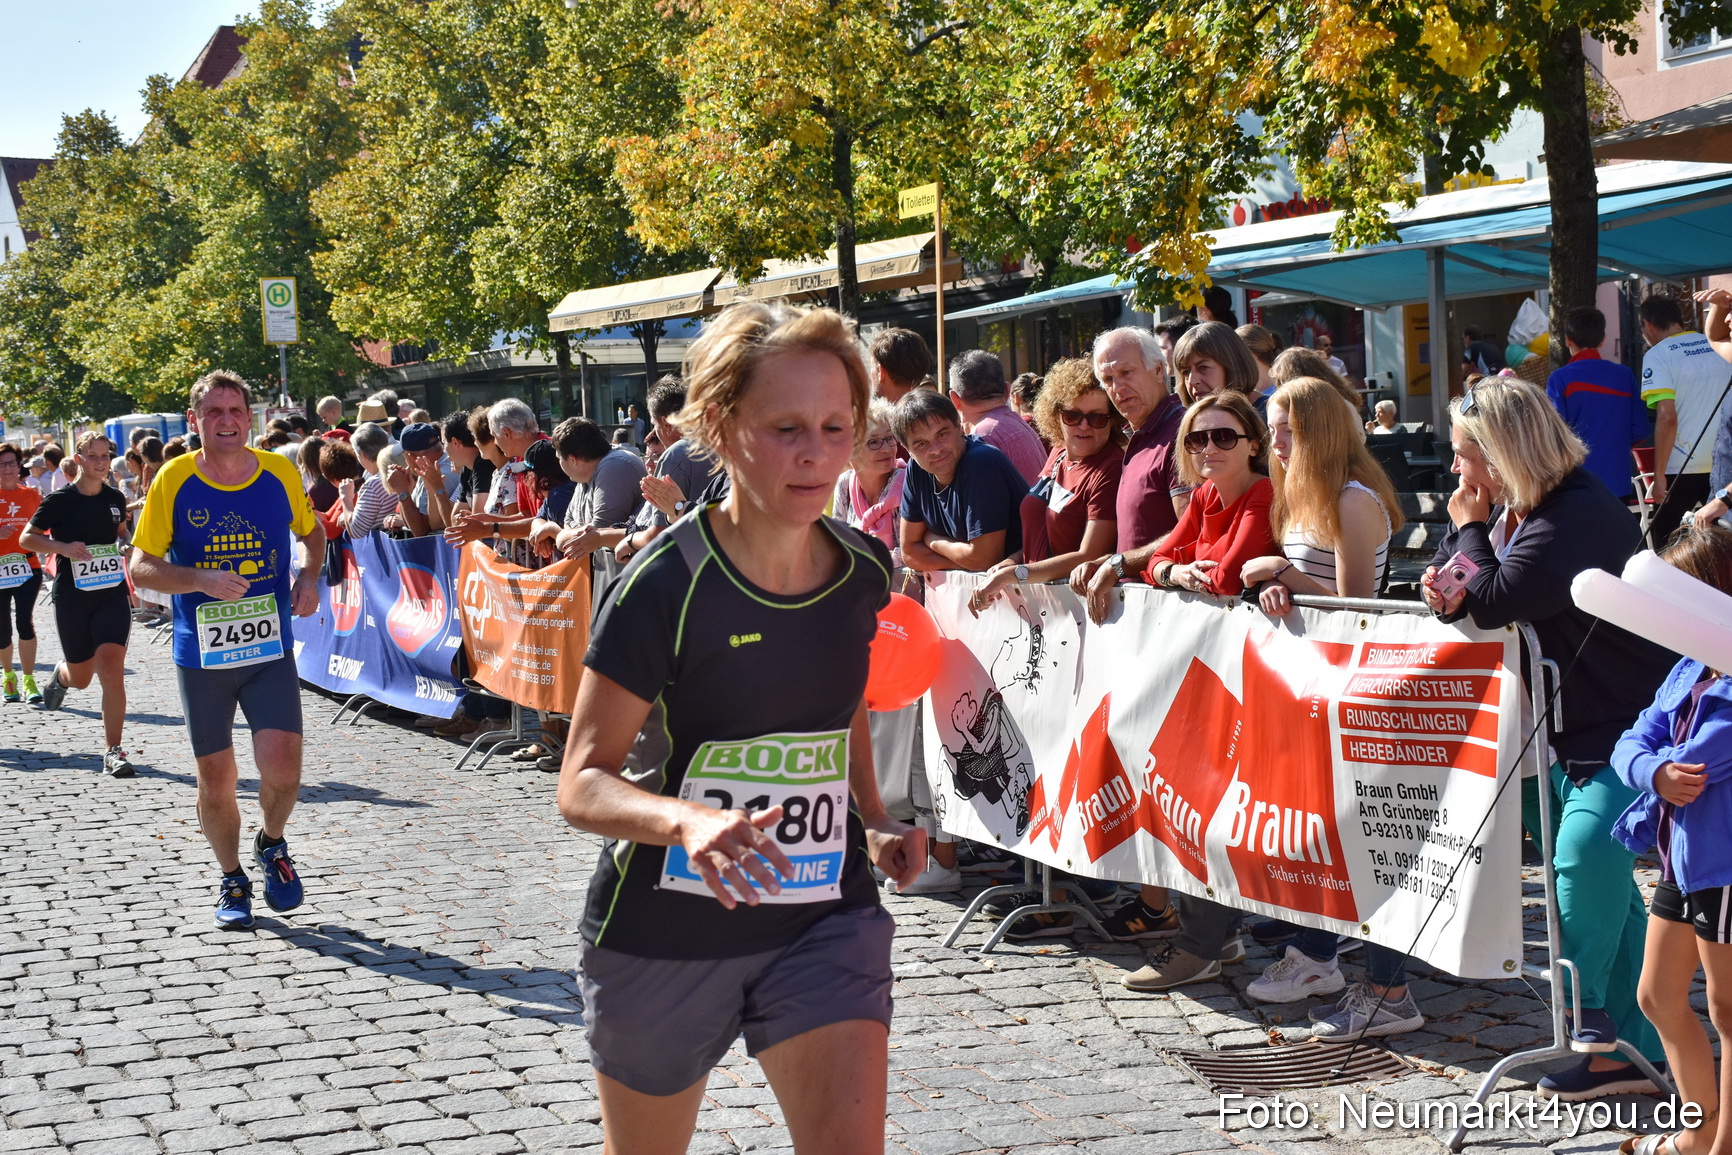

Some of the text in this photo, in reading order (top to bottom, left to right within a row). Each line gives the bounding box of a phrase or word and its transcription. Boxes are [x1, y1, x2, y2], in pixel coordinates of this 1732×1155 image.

[905, 193, 936, 210] Toiletten
[1668, 339, 1708, 351] 20. Neumar
[1683, 347, 1715, 357] Stadtlau
[78, 558, 119, 577] 2449
[543, 572, 567, 583] Partner
[538, 586, 574, 602] Umsetzung
[203, 598, 271, 621] BOCK
[534, 601, 564, 613] Internet,
[208, 619, 272, 648] 2490
[549, 618, 576, 631] angeht.
[740, 633, 762, 644] JAKO
[878, 629, 908, 642] energie
[223, 646, 262, 662] PETER
[533, 644, 544, 655] bei
[1366, 647, 1438, 665] BINDESTRICKE
[540, 674, 556, 686] 897
[1350, 677, 1475, 698] VERZURRSYSTEME
[1310, 695, 1321, 719] Seit
[1346, 708, 1468, 732] RUNDSCHLINGEN
[1227, 719, 1243, 760] Seit 1929
[700, 738, 839, 779] BOCK
[1349, 741, 1449, 763] HEBEBÄNDER
[1141, 750, 1202, 849] Braun
[1355, 780, 1438, 801] Braun GmbH
[1076, 774, 1132, 837] Braun
[1359, 801, 1448, 827] Am Grünberg 8
[1101, 818, 1121, 834] Sicher
[1120, 812, 1129, 824] ist
[1225, 779, 1333, 867] Braun
[1362, 821, 1414, 840] D-92318
[1163, 818, 1178, 843] Sicher
[1179, 837, 1187, 851] ist
[1368, 849, 1392, 866] Tel.
[1395, 851, 1424, 873] 09181
[1266, 863, 1351, 892] Sicher ist sicher
[1374, 869, 1396, 887] Fax
[1398, 872, 1423, 895] 09181
